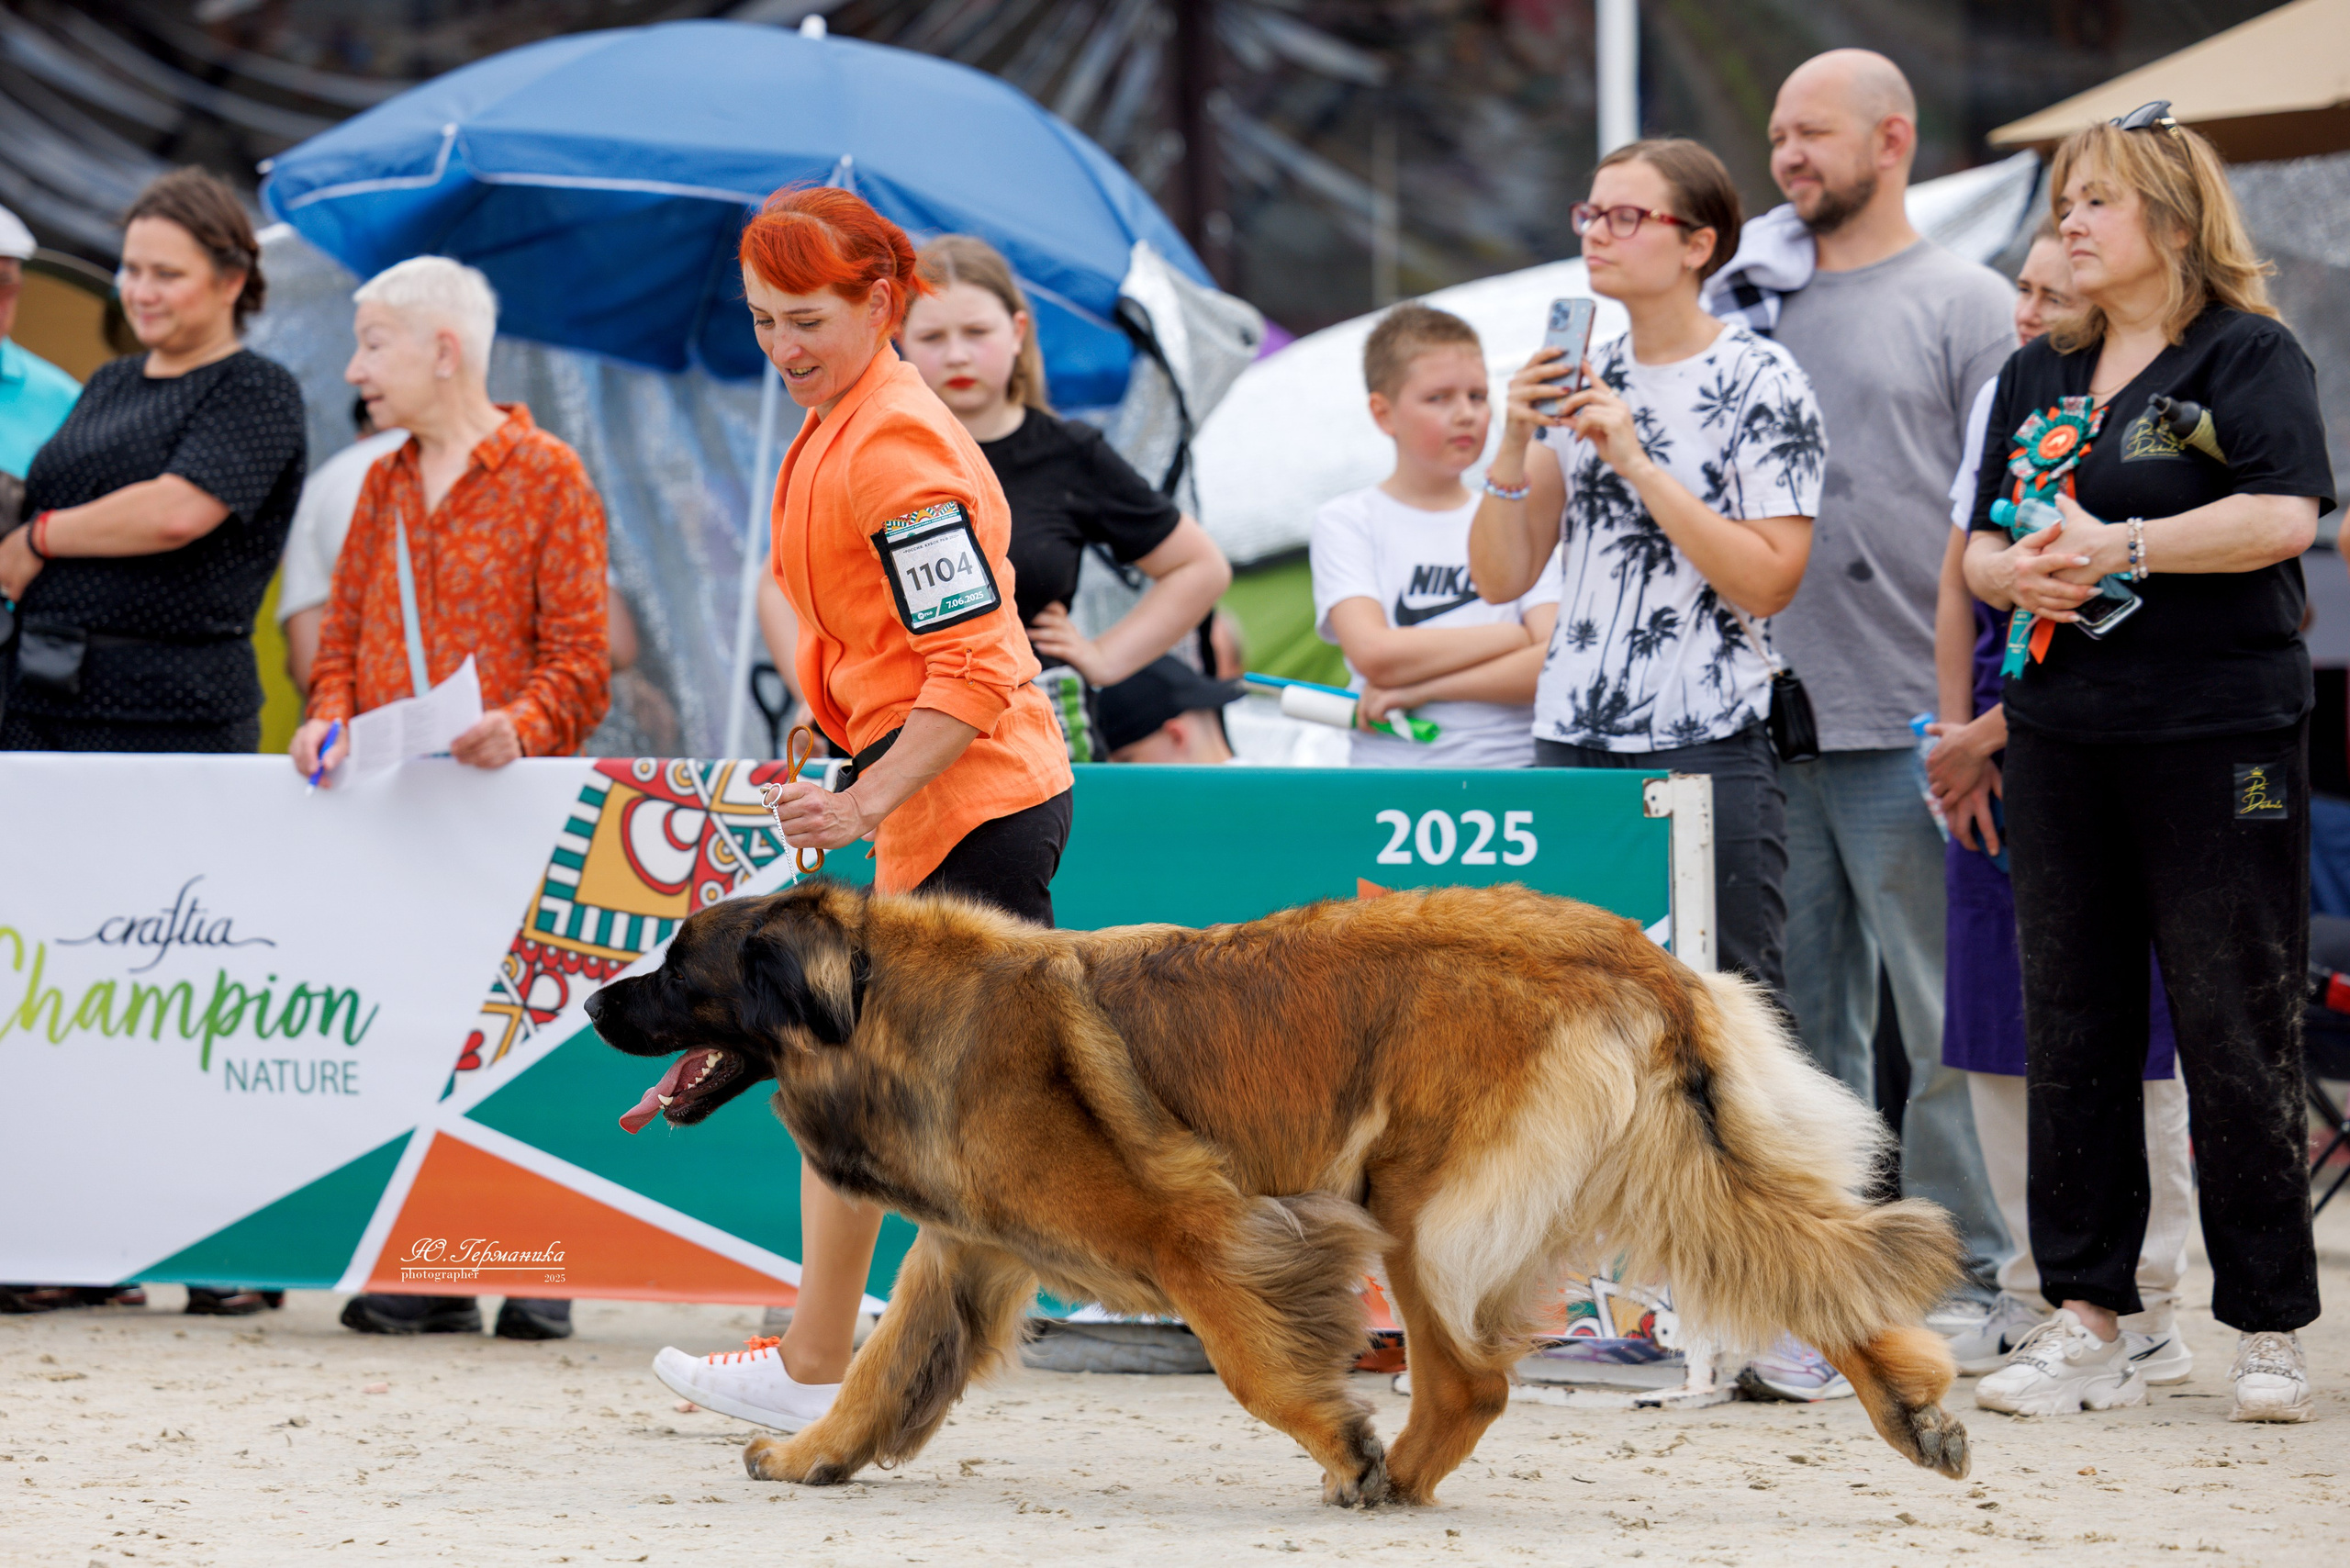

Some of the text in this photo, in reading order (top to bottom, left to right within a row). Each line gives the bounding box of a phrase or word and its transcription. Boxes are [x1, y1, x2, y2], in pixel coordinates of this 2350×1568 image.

[906, 551, 973, 591] 1104
[1408, 566, 1473, 595] NIK
[946, 591, 984, 609] 7.06.2025
[1375, 809, 1539, 866] 2025
[55, 874, 278, 974] craftia
[224, 1058, 360, 1095] NATURE
